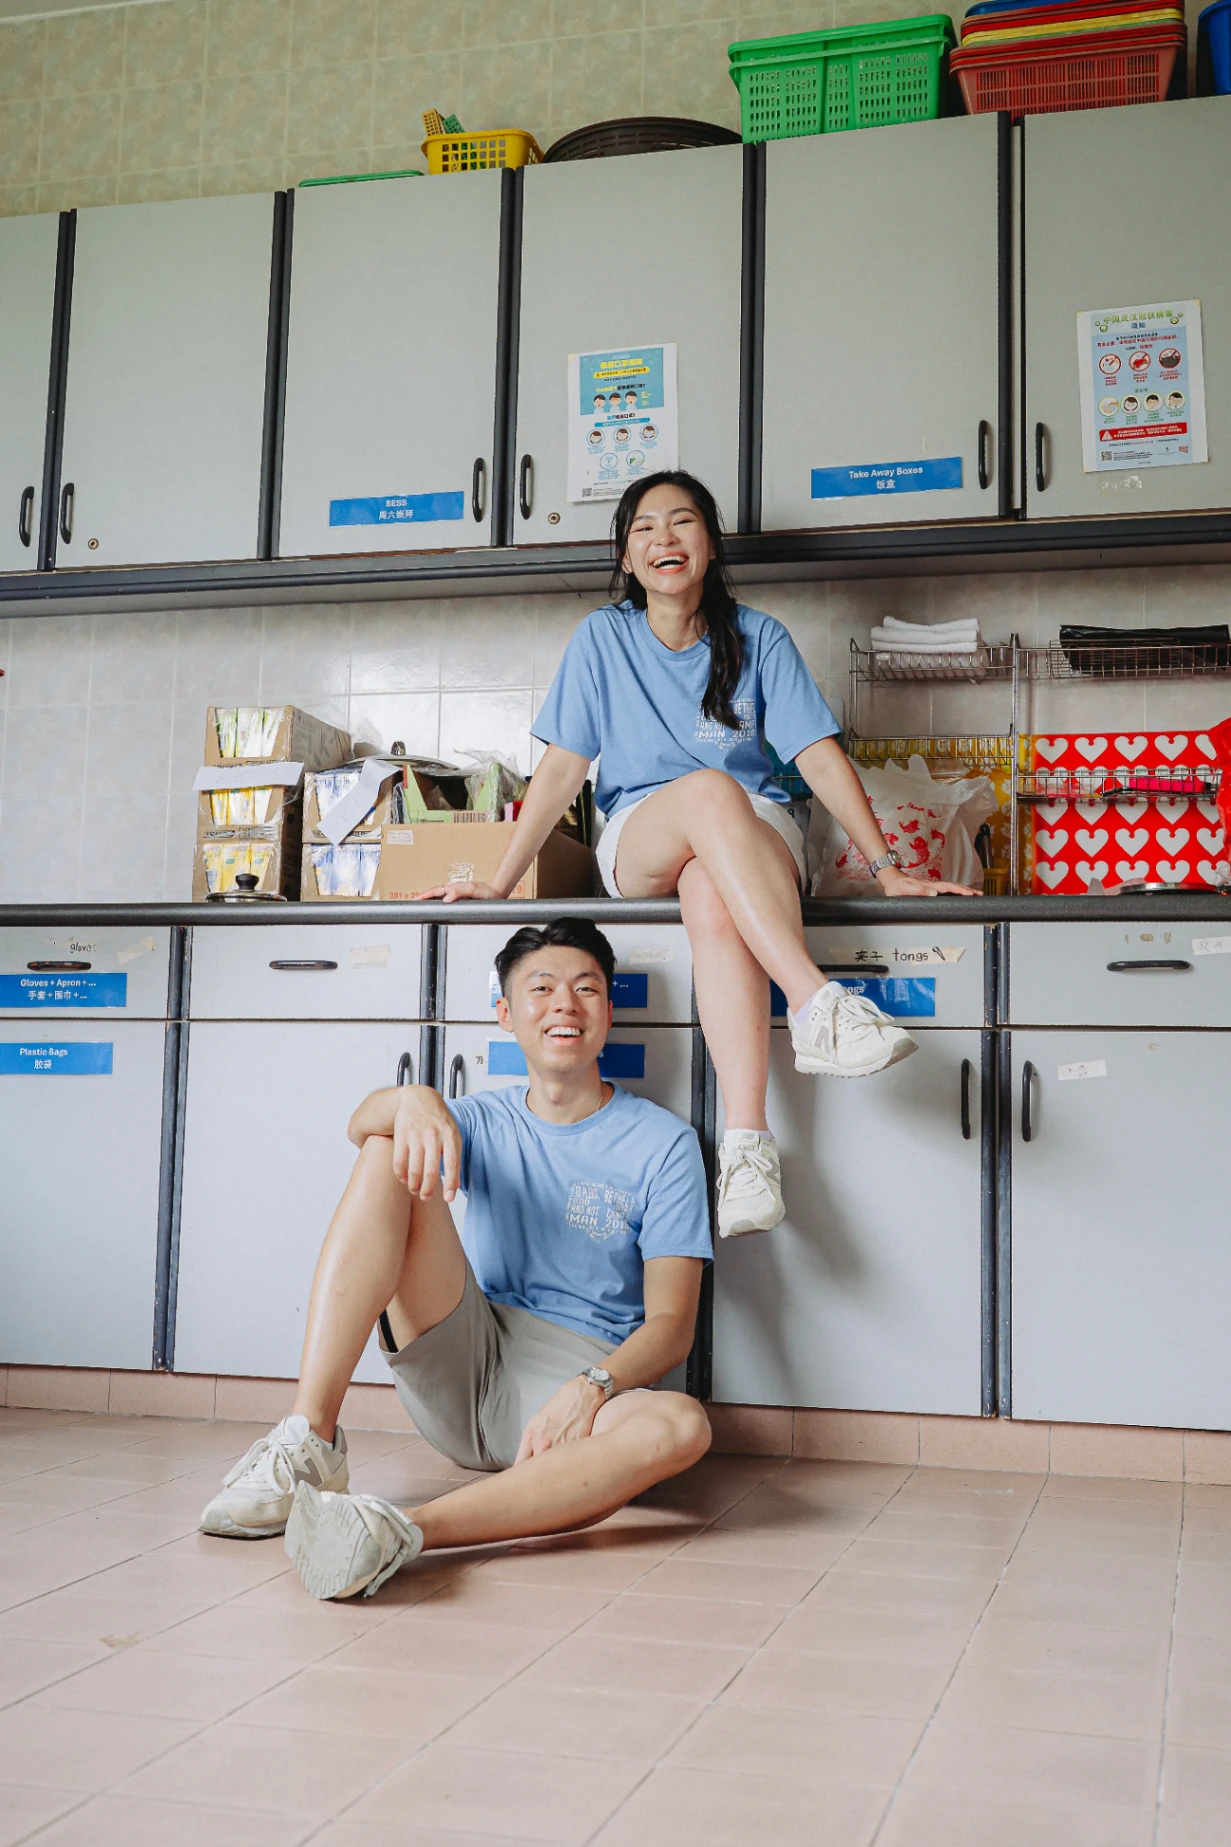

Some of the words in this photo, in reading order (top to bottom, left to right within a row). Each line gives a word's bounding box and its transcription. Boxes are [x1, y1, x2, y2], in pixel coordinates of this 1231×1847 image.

[848, 470, 869, 479] Take
[870, 468, 895, 479] Away
[896, 467, 924, 476] Boxes
[875, 479, 896, 490] 饭盒
[386, 499, 408, 507] BESS
[379, 510, 414, 520] 周六崇拜
[698, 730, 726, 738] MAN
[732, 730, 755, 738] 2018
[892, 948, 929, 962] tongs
[20, 978, 49, 987] Gloves
[56, 978, 81, 987] Apron
[28, 990, 47, 1000] 手套
[54, 990, 72, 1000] 围巾
[19, 1047, 47, 1056] Plastic
[48, 1048, 69, 1057] Bags
[34, 1059, 52, 1070] 胶袋
[571, 1204, 585, 1214] AND
[586, 1206, 600, 1216] NOT
[569, 1213, 598, 1226] MAN
